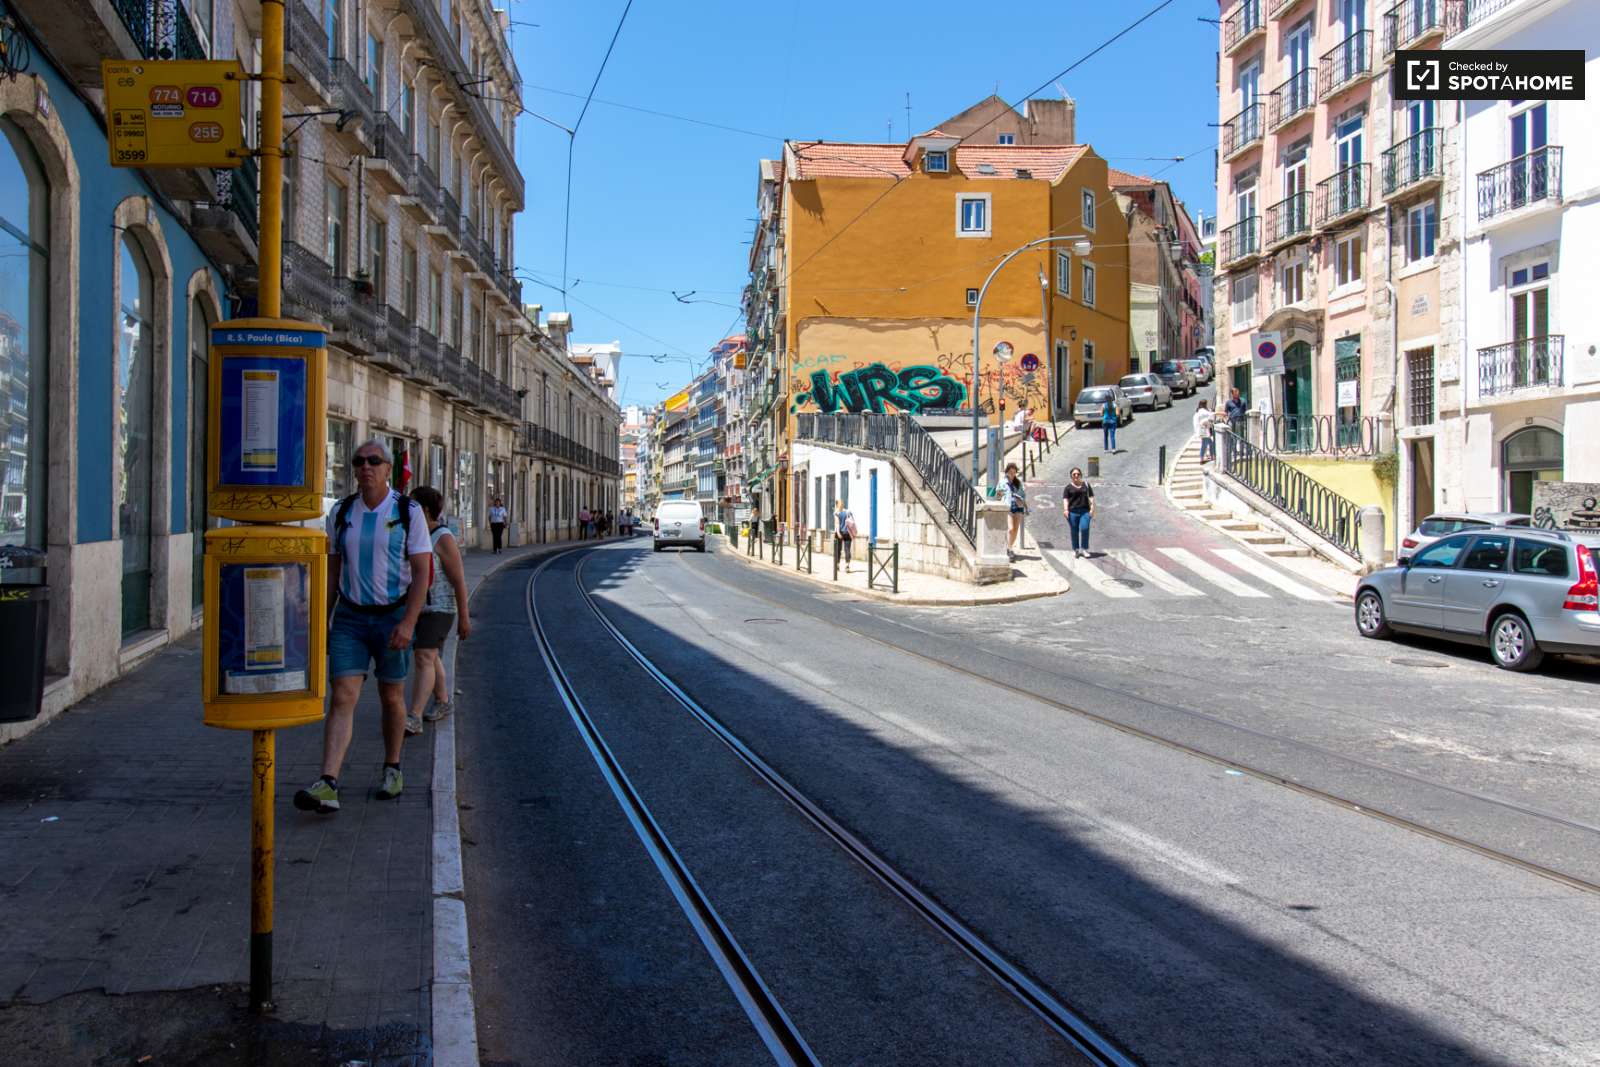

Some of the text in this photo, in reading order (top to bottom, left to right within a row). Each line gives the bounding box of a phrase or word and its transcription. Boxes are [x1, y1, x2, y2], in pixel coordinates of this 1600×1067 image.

[154, 90, 179, 101] 774
[191, 91, 217, 103] 714
[193, 127, 220, 139] 25E
[118, 150, 146, 160] 3599
[227, 334, 303, 344] R. S. Paulo (Bica)
[810, 363, 967, 416] WRS
